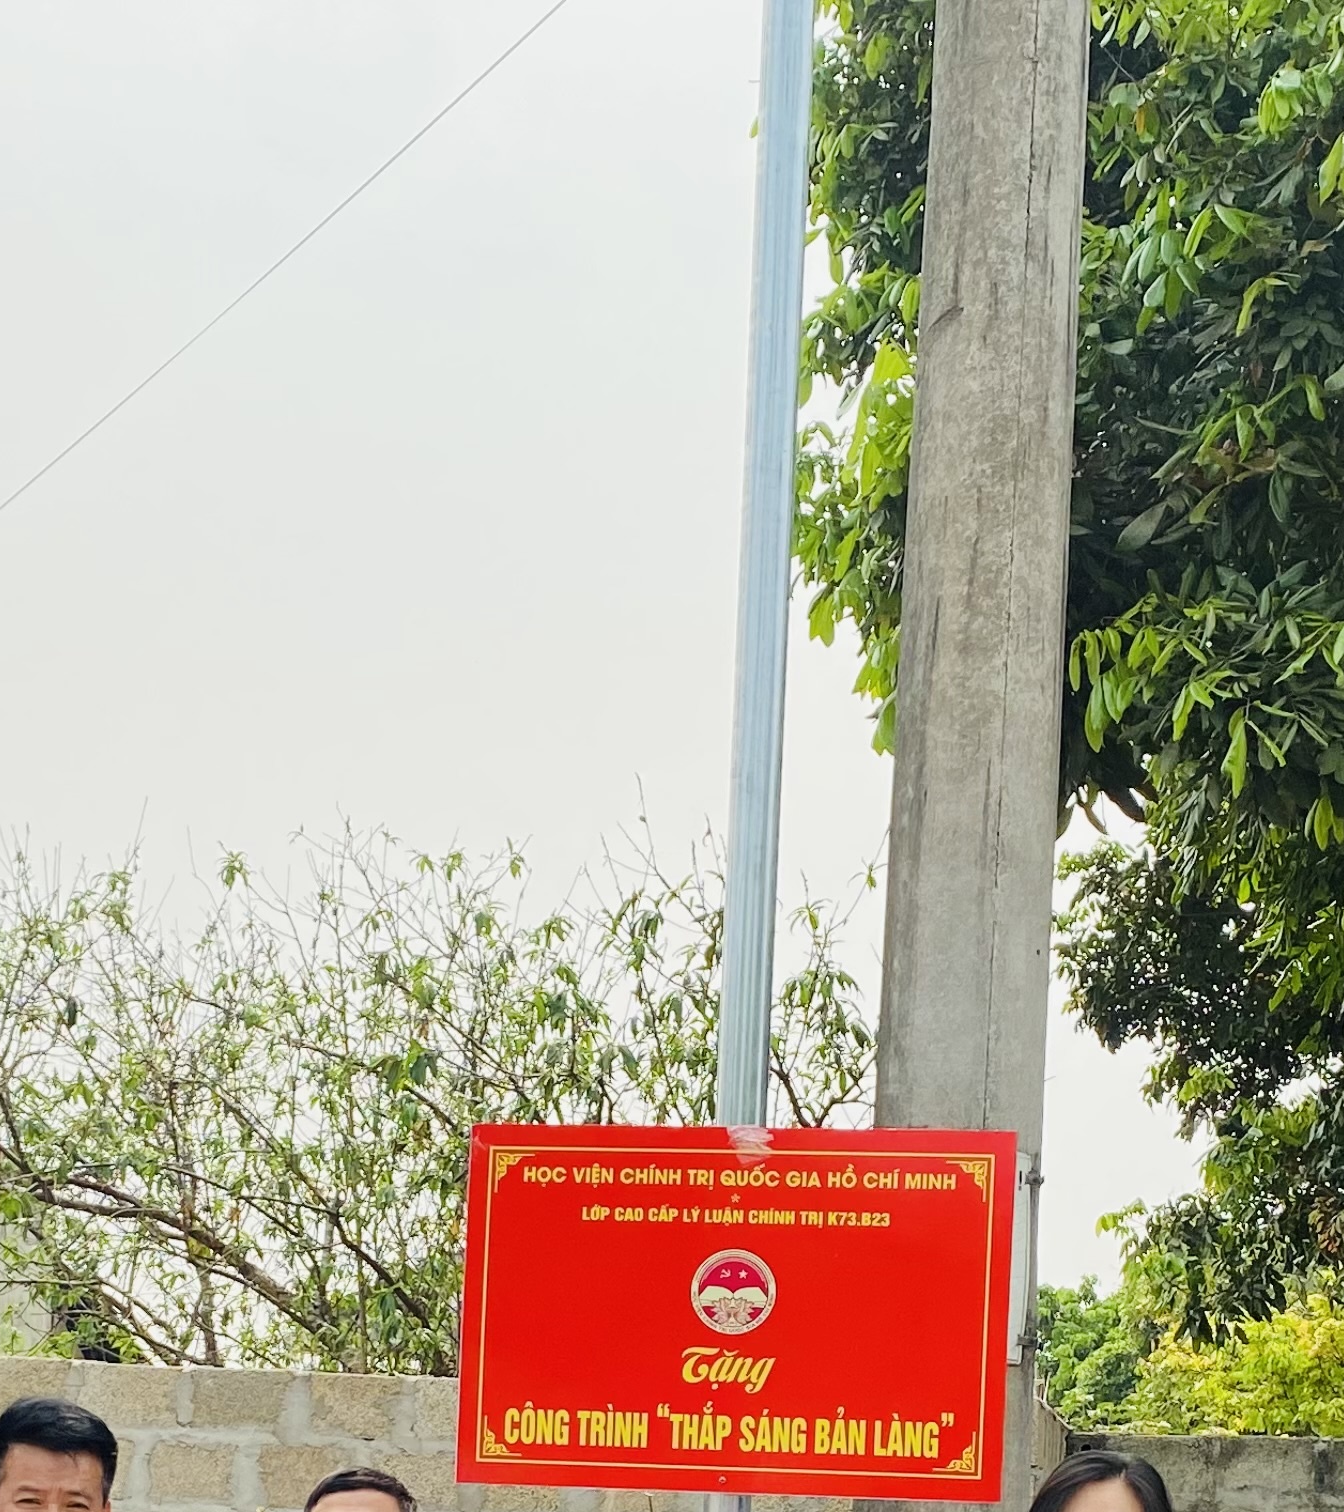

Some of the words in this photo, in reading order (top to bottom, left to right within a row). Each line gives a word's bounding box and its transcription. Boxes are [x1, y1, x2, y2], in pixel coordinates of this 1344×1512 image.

[523, 1166, 567, 1188] HỌC
[573, 1163, 614, 1189] VIỆN
[620, 1163, 682, 1185] CHÍNH
[687, 1169, 714, 1190] TRỊ
[719, 1163, 780, 1188] QUỐC
[785, 1171, 822, 1188] GIA
[827, 1164, 857, 1189] HỒ
[863, 1168, 900, 1190] CHÍ
[905, 1173, 956, 1191] MINH
[581, 1204, 610, 1221] LỚP
[614, 1207, 644, 1222] CAO
[648, 1204, 679, 1223] CẤP
[682, 1206, 701, 1223] LÝ
[704, 1206, 744, 1227] LUẬN
[748, 1208, 796, 1225] CHÍNH
[800, 1211, 824, 1229] TRỊ
[827, 1211, 891, 1227] K73.B23
[681, 1347, 777, 1394] Tặng
[504, 1400, 570, 1446] CÔNG
[577, 1403, 649, 1449] TRÌNH
[738, 1408, 808, 1454] SÁNG
[814, 1406, 867, 1456] BẢN
